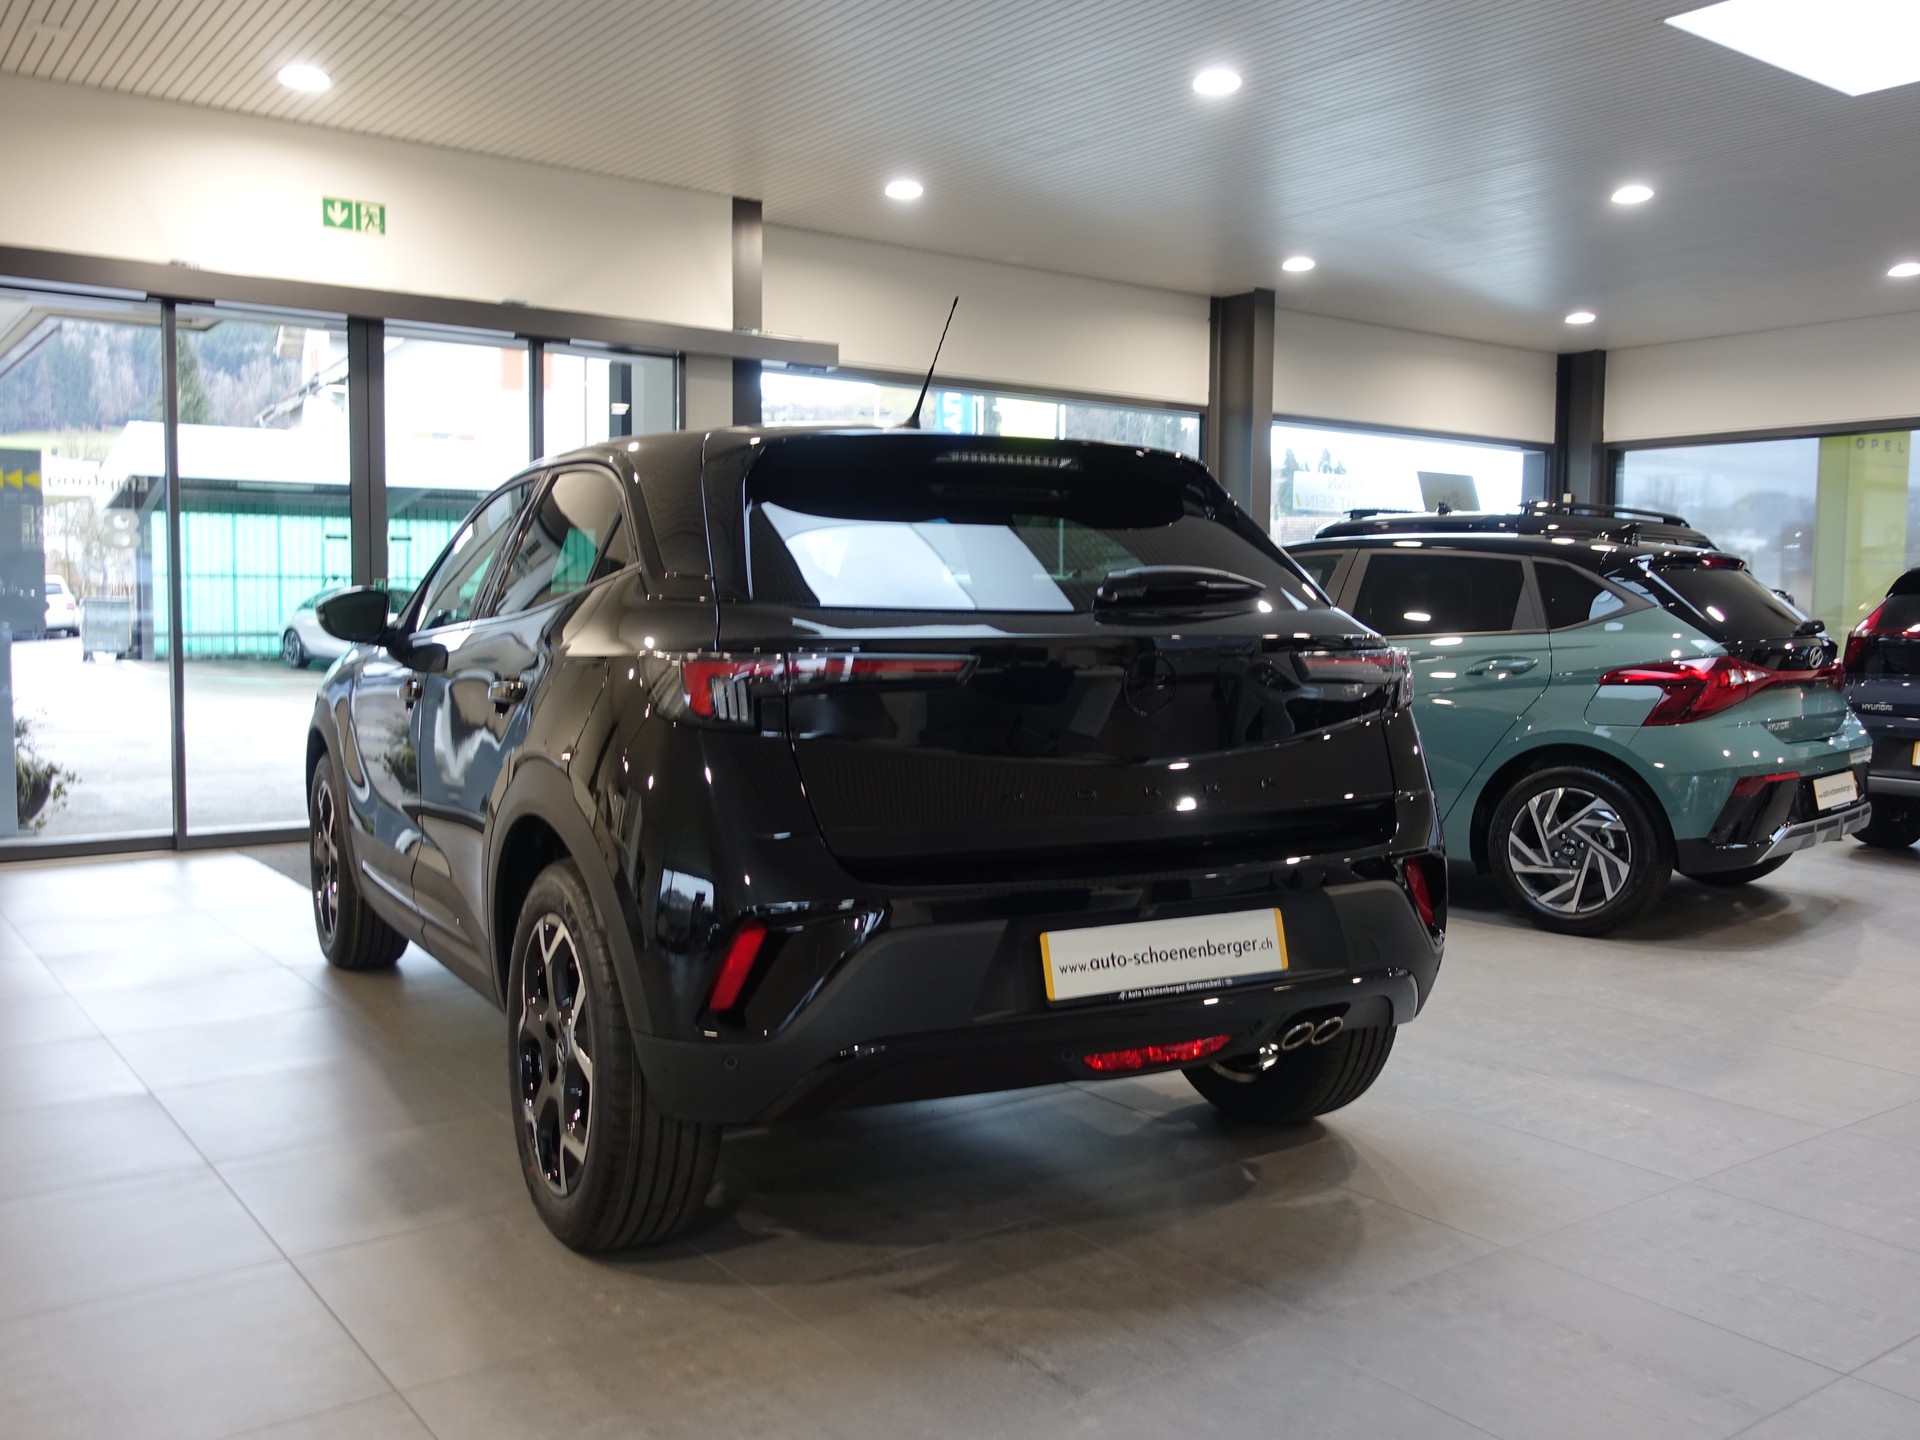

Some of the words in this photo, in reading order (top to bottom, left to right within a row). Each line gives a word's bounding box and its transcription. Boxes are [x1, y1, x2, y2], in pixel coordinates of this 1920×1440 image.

[1856, 437, 1905, 453] OPEL
[1862, 703, 1893, 711] HYUNDAI
[1059, 937, 1273, 975] www.auto-schoenenberger.ch
